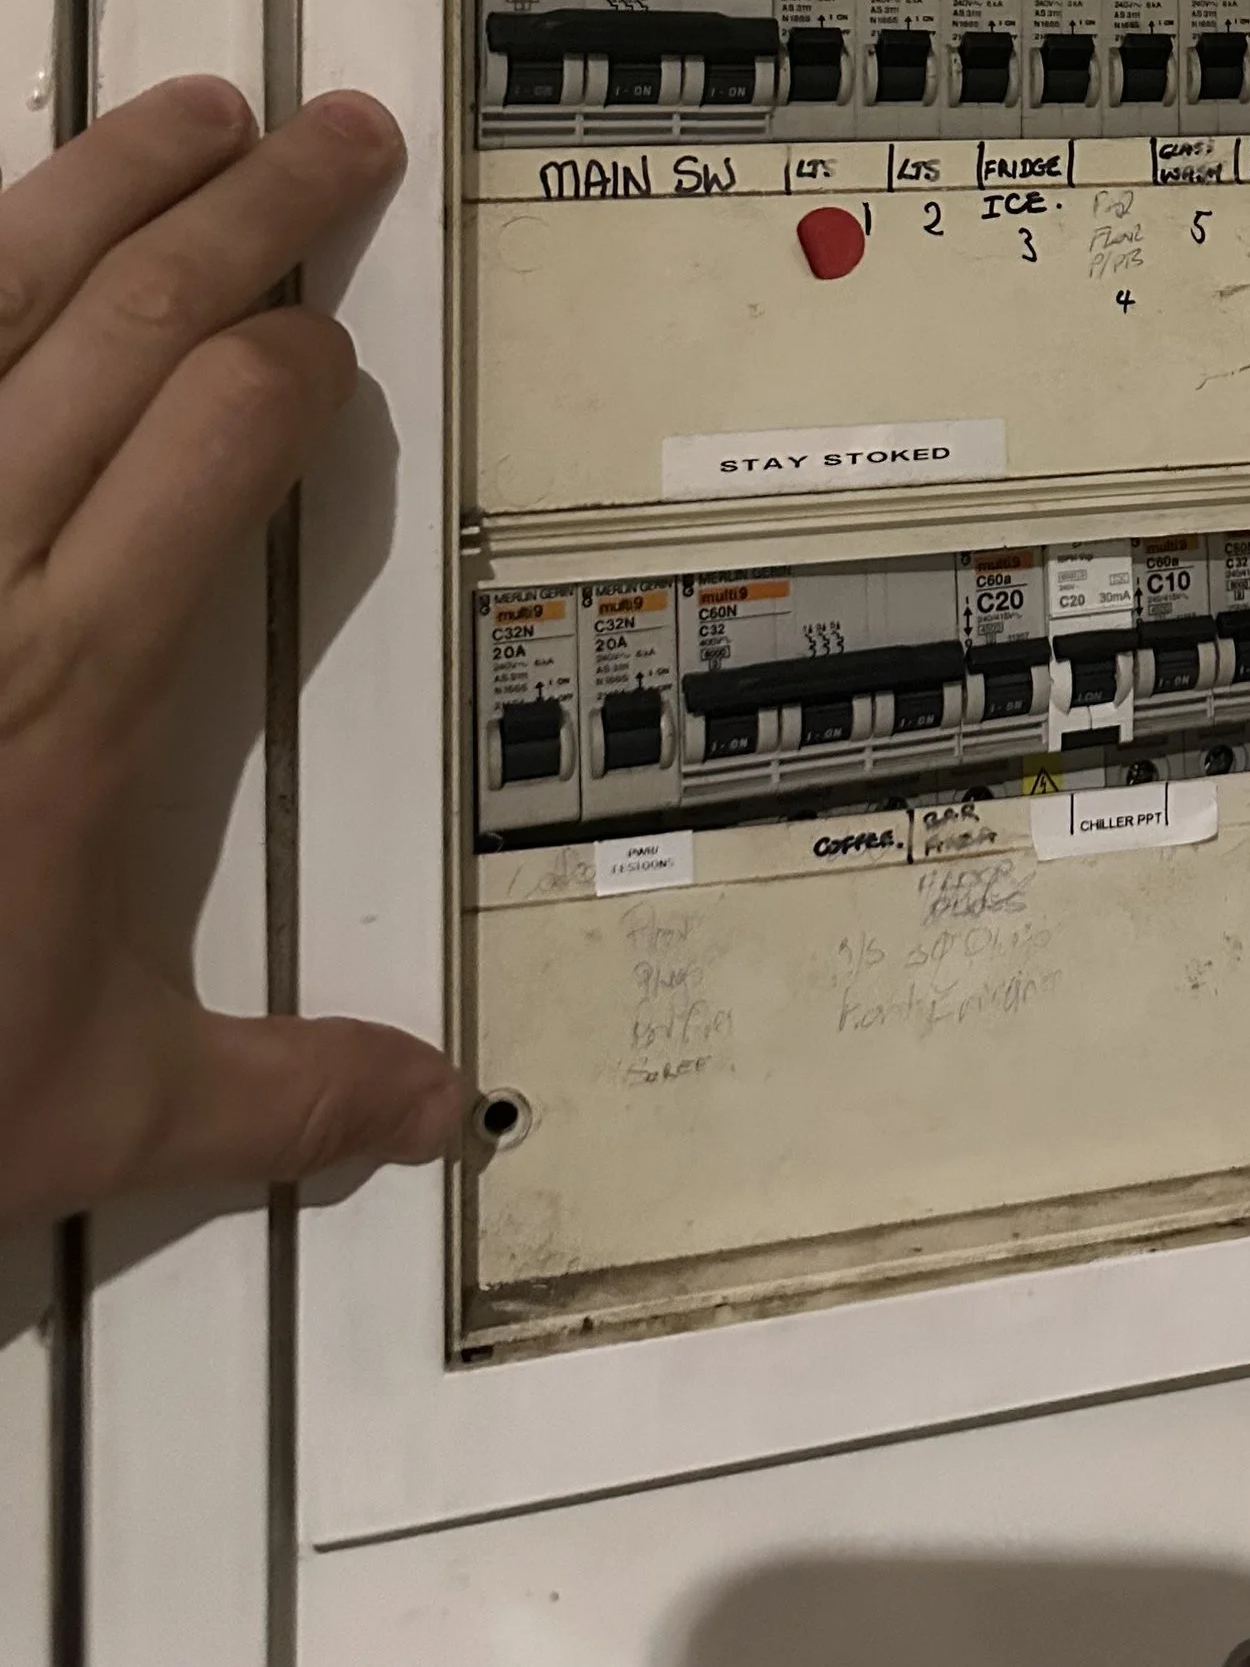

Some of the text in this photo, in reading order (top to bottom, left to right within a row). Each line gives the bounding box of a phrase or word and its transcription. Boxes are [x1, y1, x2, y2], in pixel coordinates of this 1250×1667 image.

[540, 155, 736, 199] MAIN SW
[896, 157, 941, 182] LTS
[983, 154, 1063, 181] FRIDGE
[923, 201, 945, 236] 2
[1190, 210, 1213, 245] 5
[1018, 227, 1038, 263] 3
[1115, 289, 1136, 314] 4
[719, 446, 951, 473] STAY STOKED
[1226, 557, 1249, 569] C32
[1146, 570, 1191, 595] C10
[976, 588, 1025, 614] C20
[1059, 593, 1086, 609] C20
[1099, 590, 1131, 604] 30mA
[594, 616, 636, 633] C32N
[698, 604, 737, 621] C60N
[492, 625, 535, 642] C32N
[699, 623, 725, 637] C32
[492, 644, 526, 661] 20A
[594, 635, 628, 653] 20A
[1079, 811, 1164, 833] CHILLER PPT
